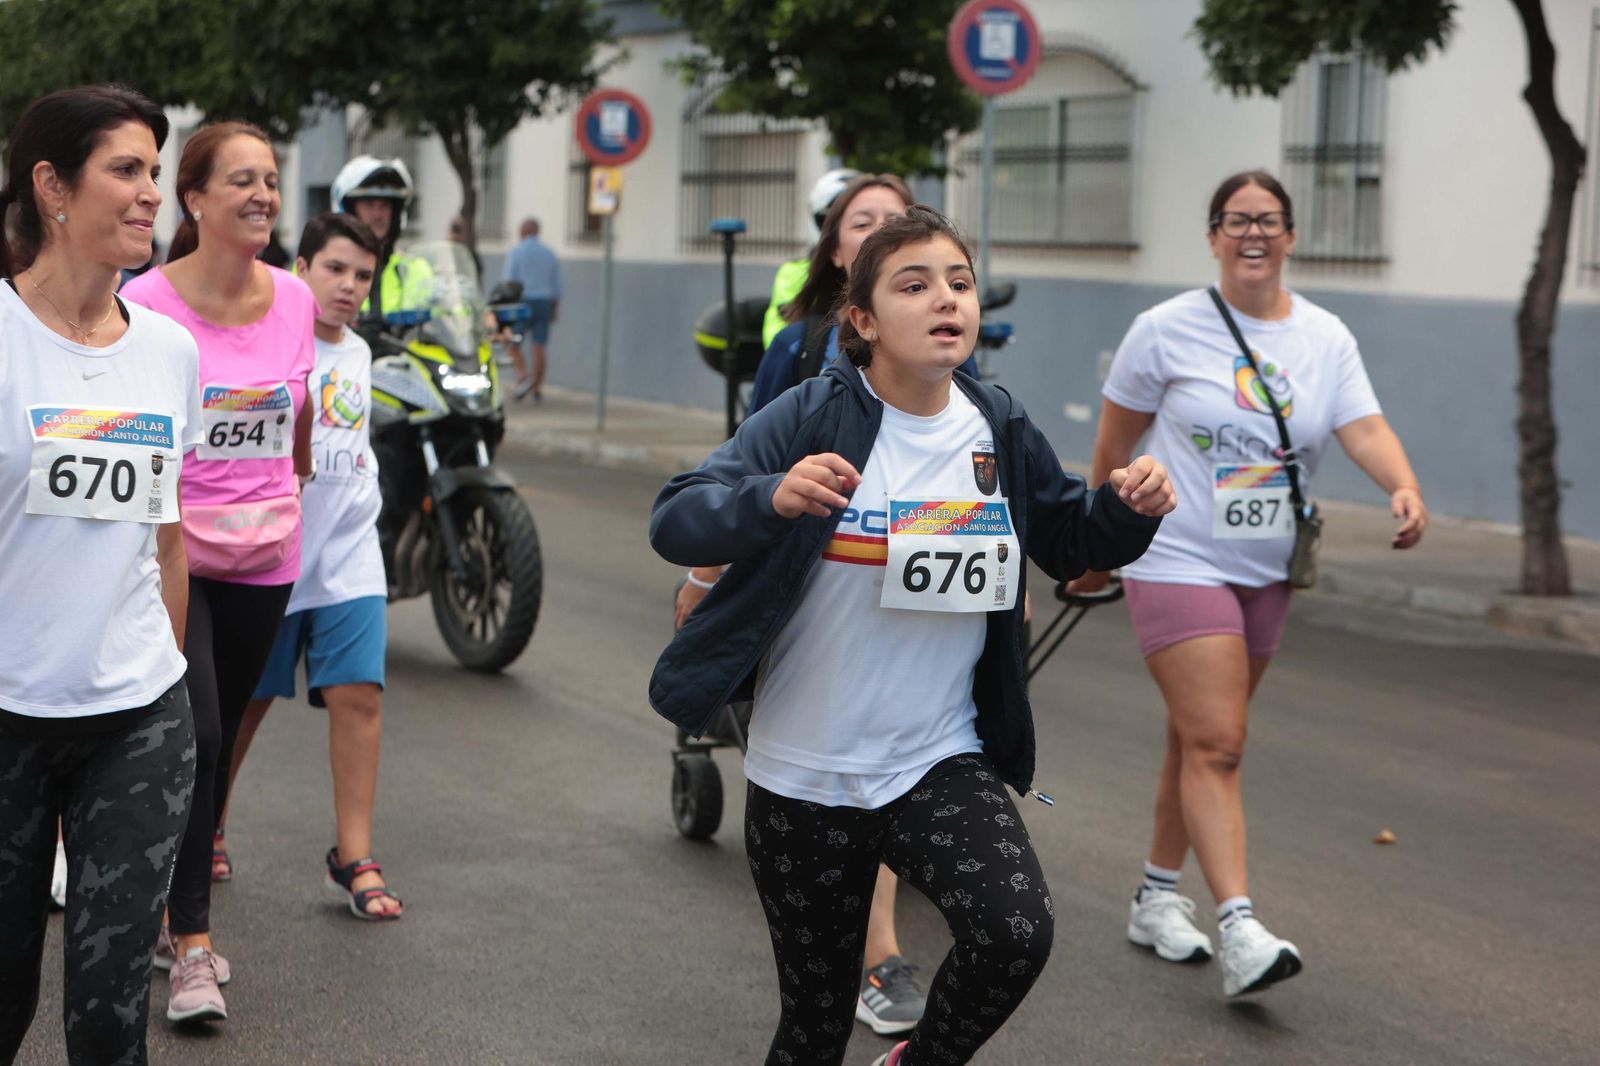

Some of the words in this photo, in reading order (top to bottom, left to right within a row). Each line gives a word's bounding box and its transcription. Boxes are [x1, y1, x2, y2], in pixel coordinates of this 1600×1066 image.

[42, 413, 104, 427] CARRERA
[108, 417, 165, 432] POPULAR
[208, 419, 265, 447] 654
[107, 430, 141, 442] SANTO
[142, 433, 172, 445] ANGEL
[48, 454, 136, 503] 670
[897, 508, 962, 521] CARRERA
[965, 509, 1002, 521] POPULAR
[1225, 499, 1281, 527] 687
[896, 522, 961, 532] ASOCIACION
[963, 523, 986, 532] SANTO
[987, 523, 1009, 533] ANGEL
[902, 551, 986, 595] 676
